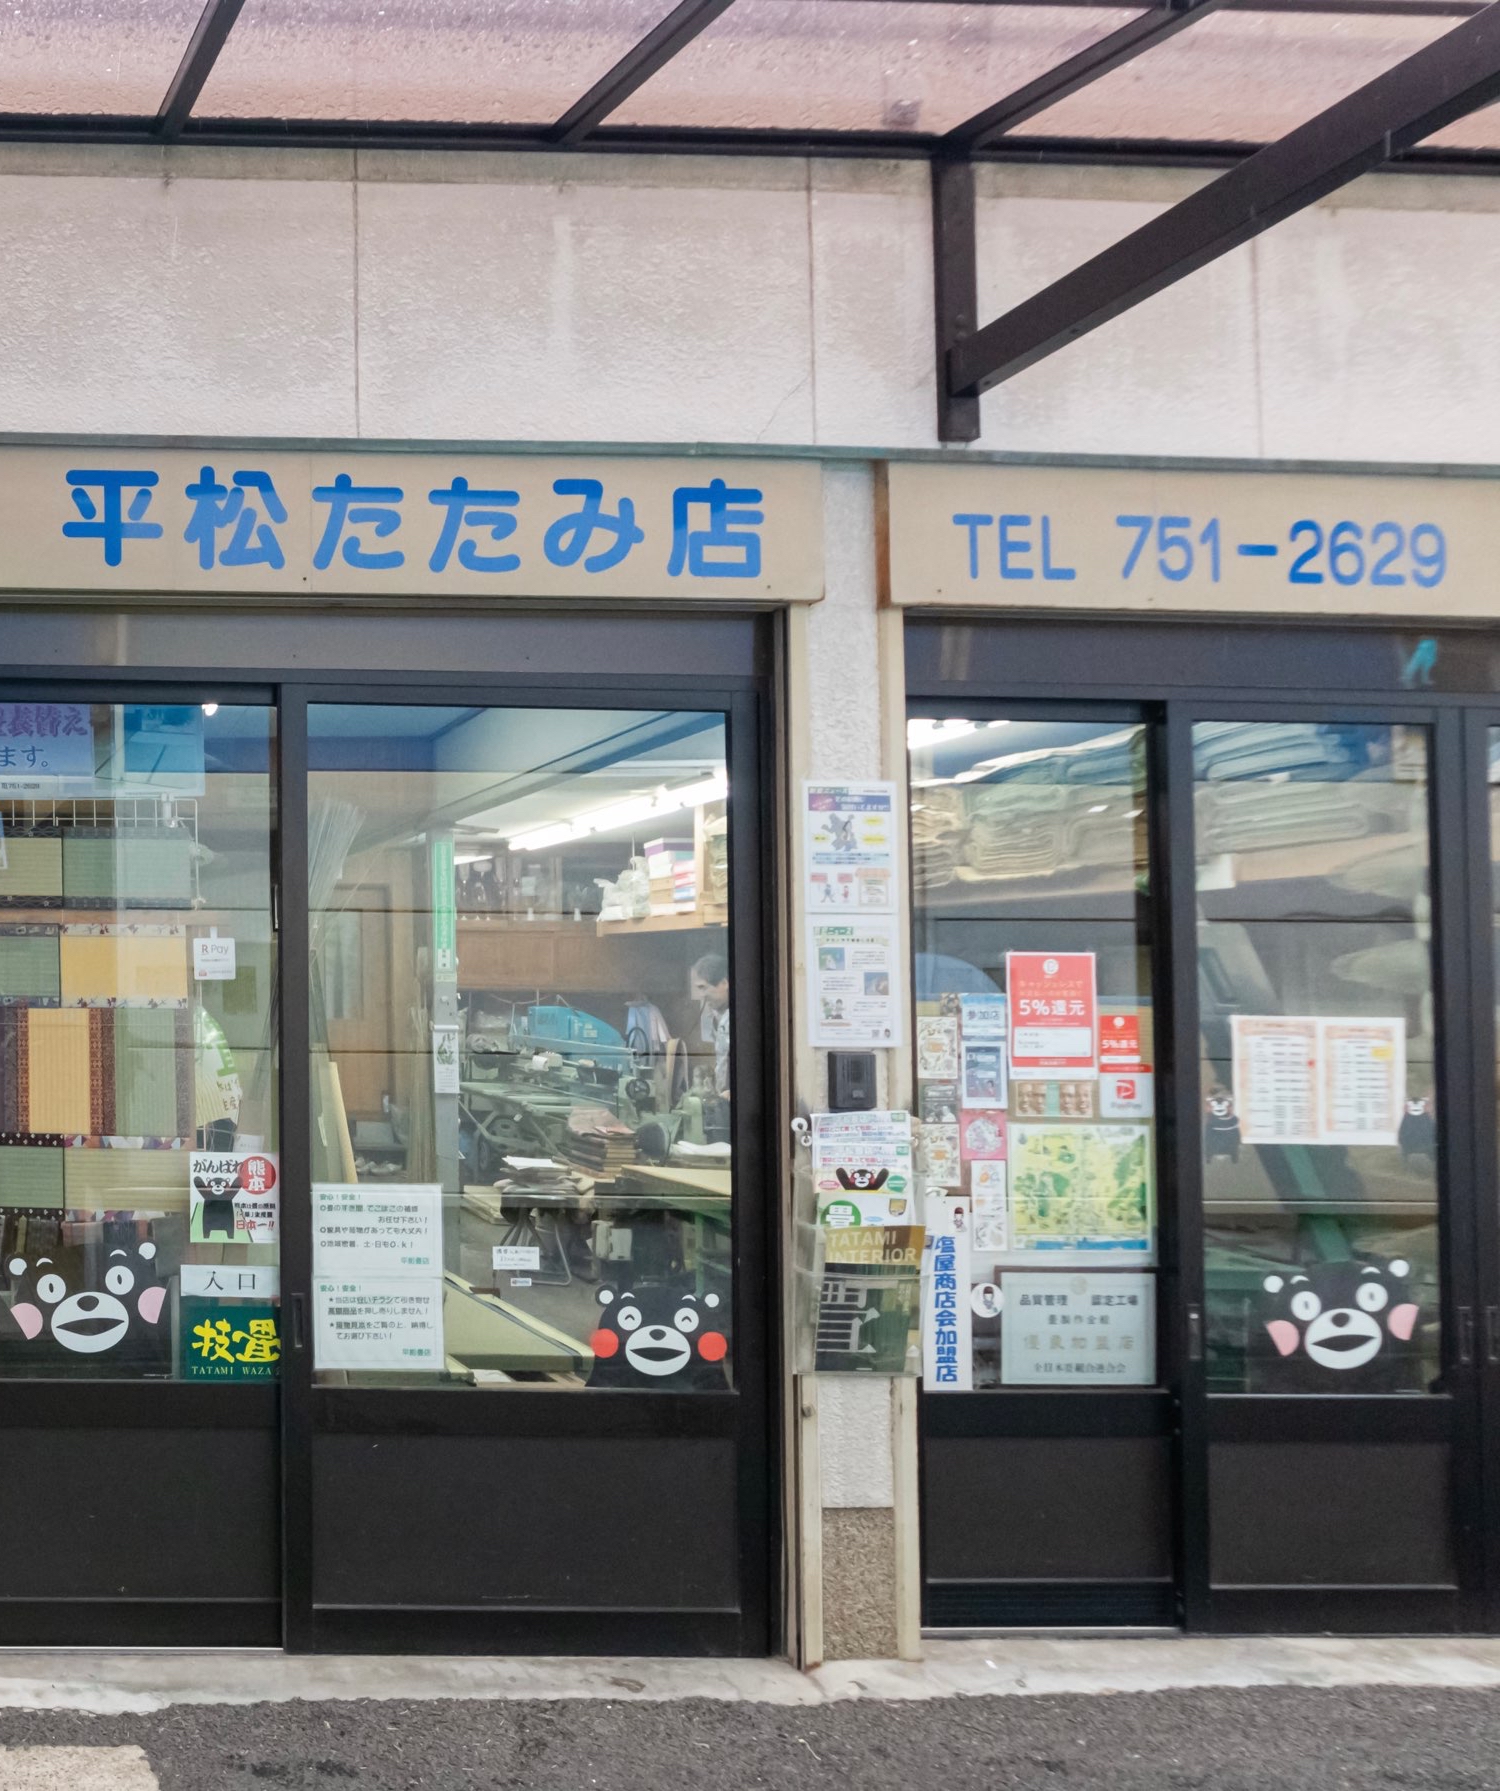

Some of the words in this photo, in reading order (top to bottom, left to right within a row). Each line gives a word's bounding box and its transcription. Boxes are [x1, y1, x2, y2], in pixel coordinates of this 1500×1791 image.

[62, 466, 765, 579] 平松たたみ店
[952, 513, 1077, 581] TEL
[1115, 515, 1448, 588] 751-2629
[1019, 999, 1086, 1016] 5%還元
[830, 1230, 897, 1247] TATAMI
[203, 1270, 256, 1291] 入口
[933, 1235, 959, 1383] 塩屋商店会加盟店
[191, 1365, 234, 1375] TATAMI
